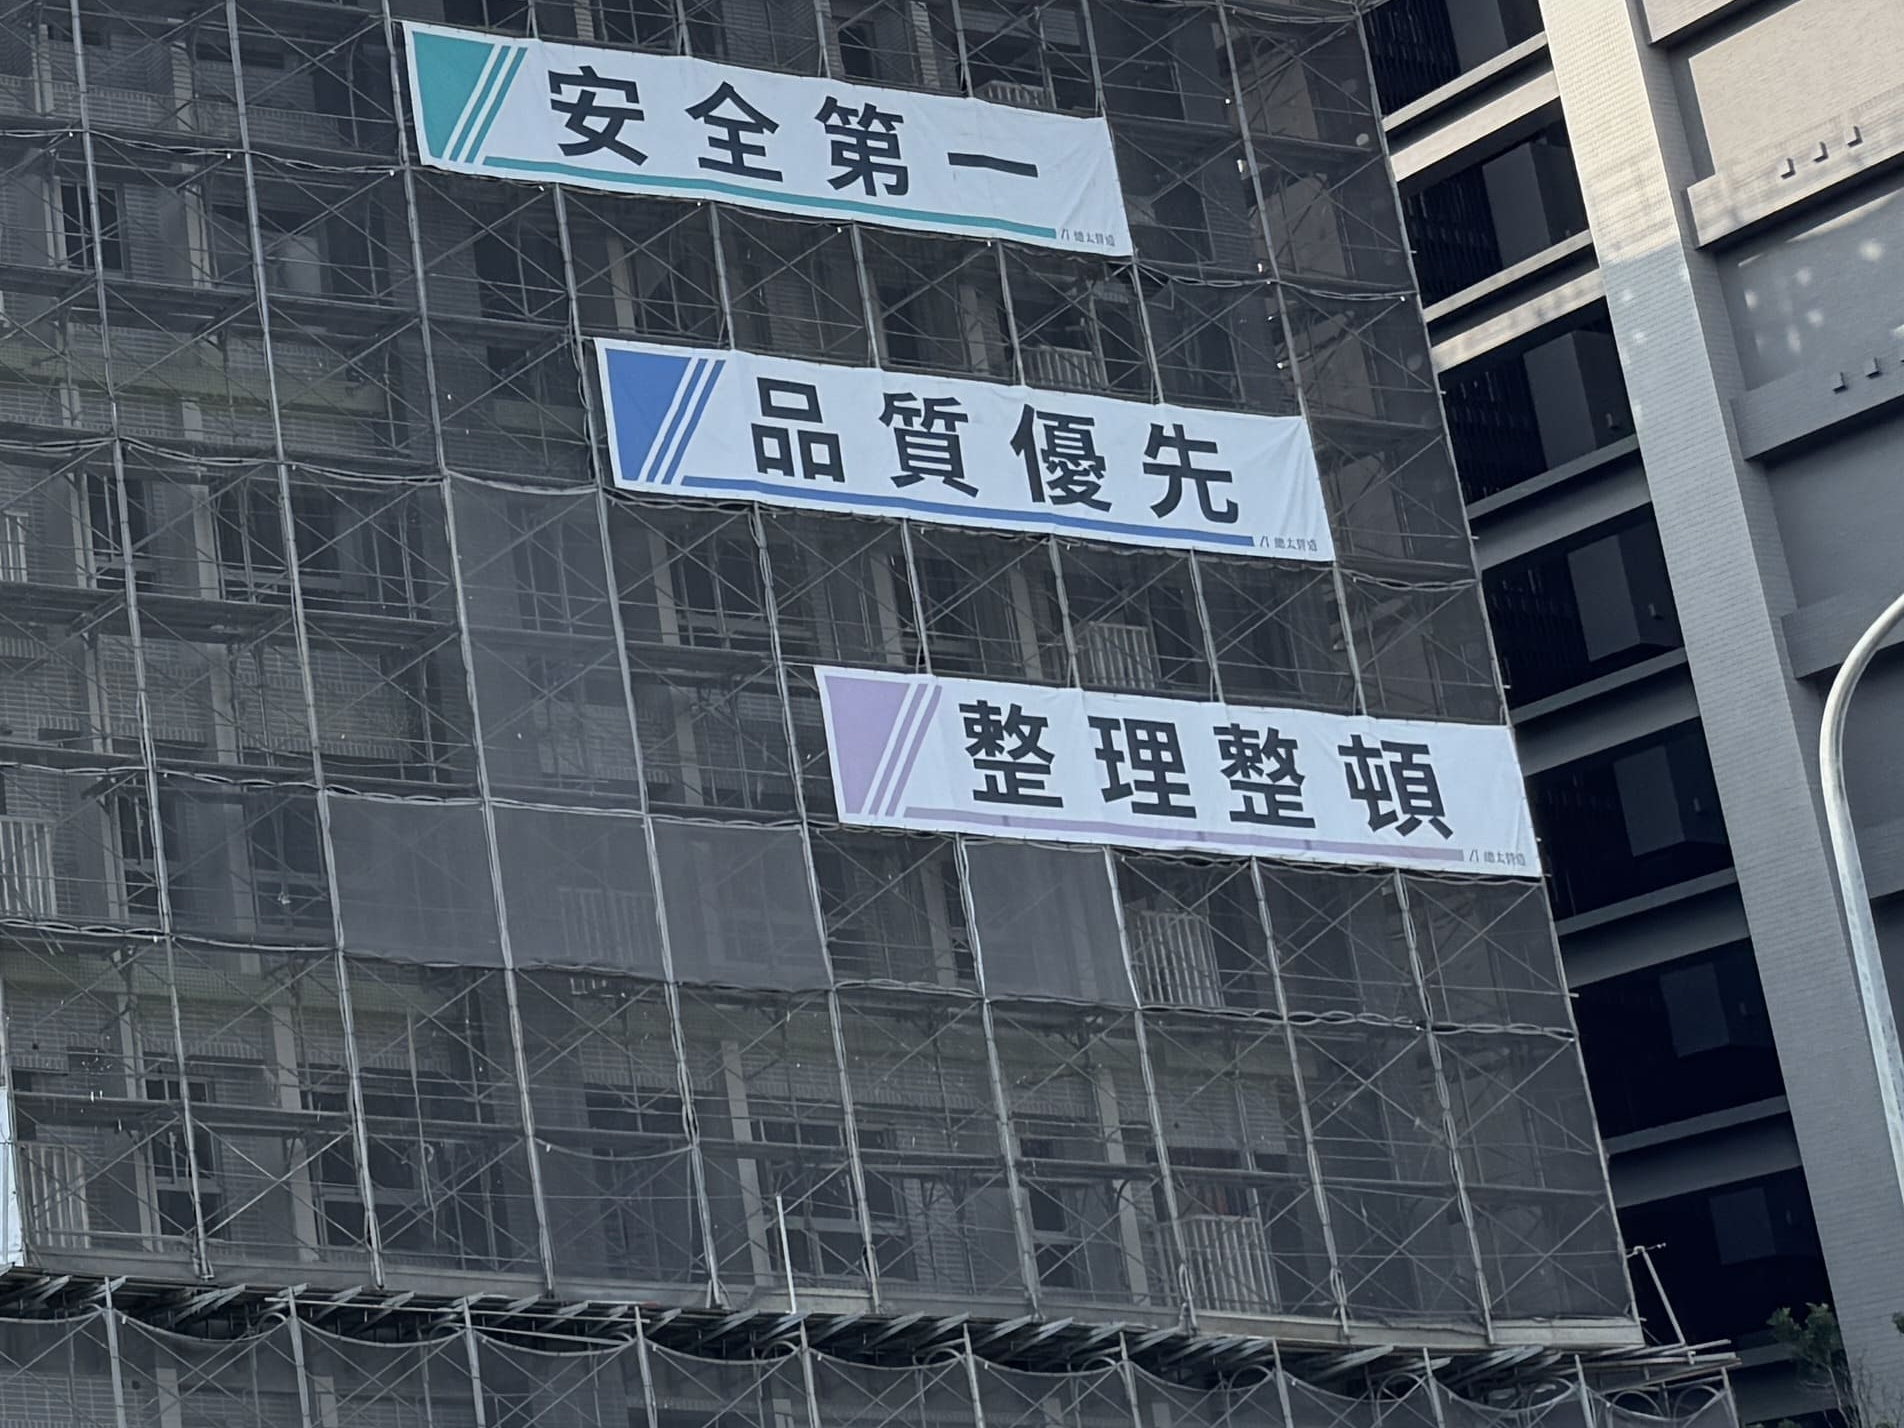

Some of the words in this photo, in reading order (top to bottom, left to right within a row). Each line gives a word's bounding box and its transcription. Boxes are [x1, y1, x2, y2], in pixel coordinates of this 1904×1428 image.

[547, 65, 1040, 198] 安全第一
[748, 381, 1240, 525] 品質優先
[958, 698, 1455, 840] 整理整頓
